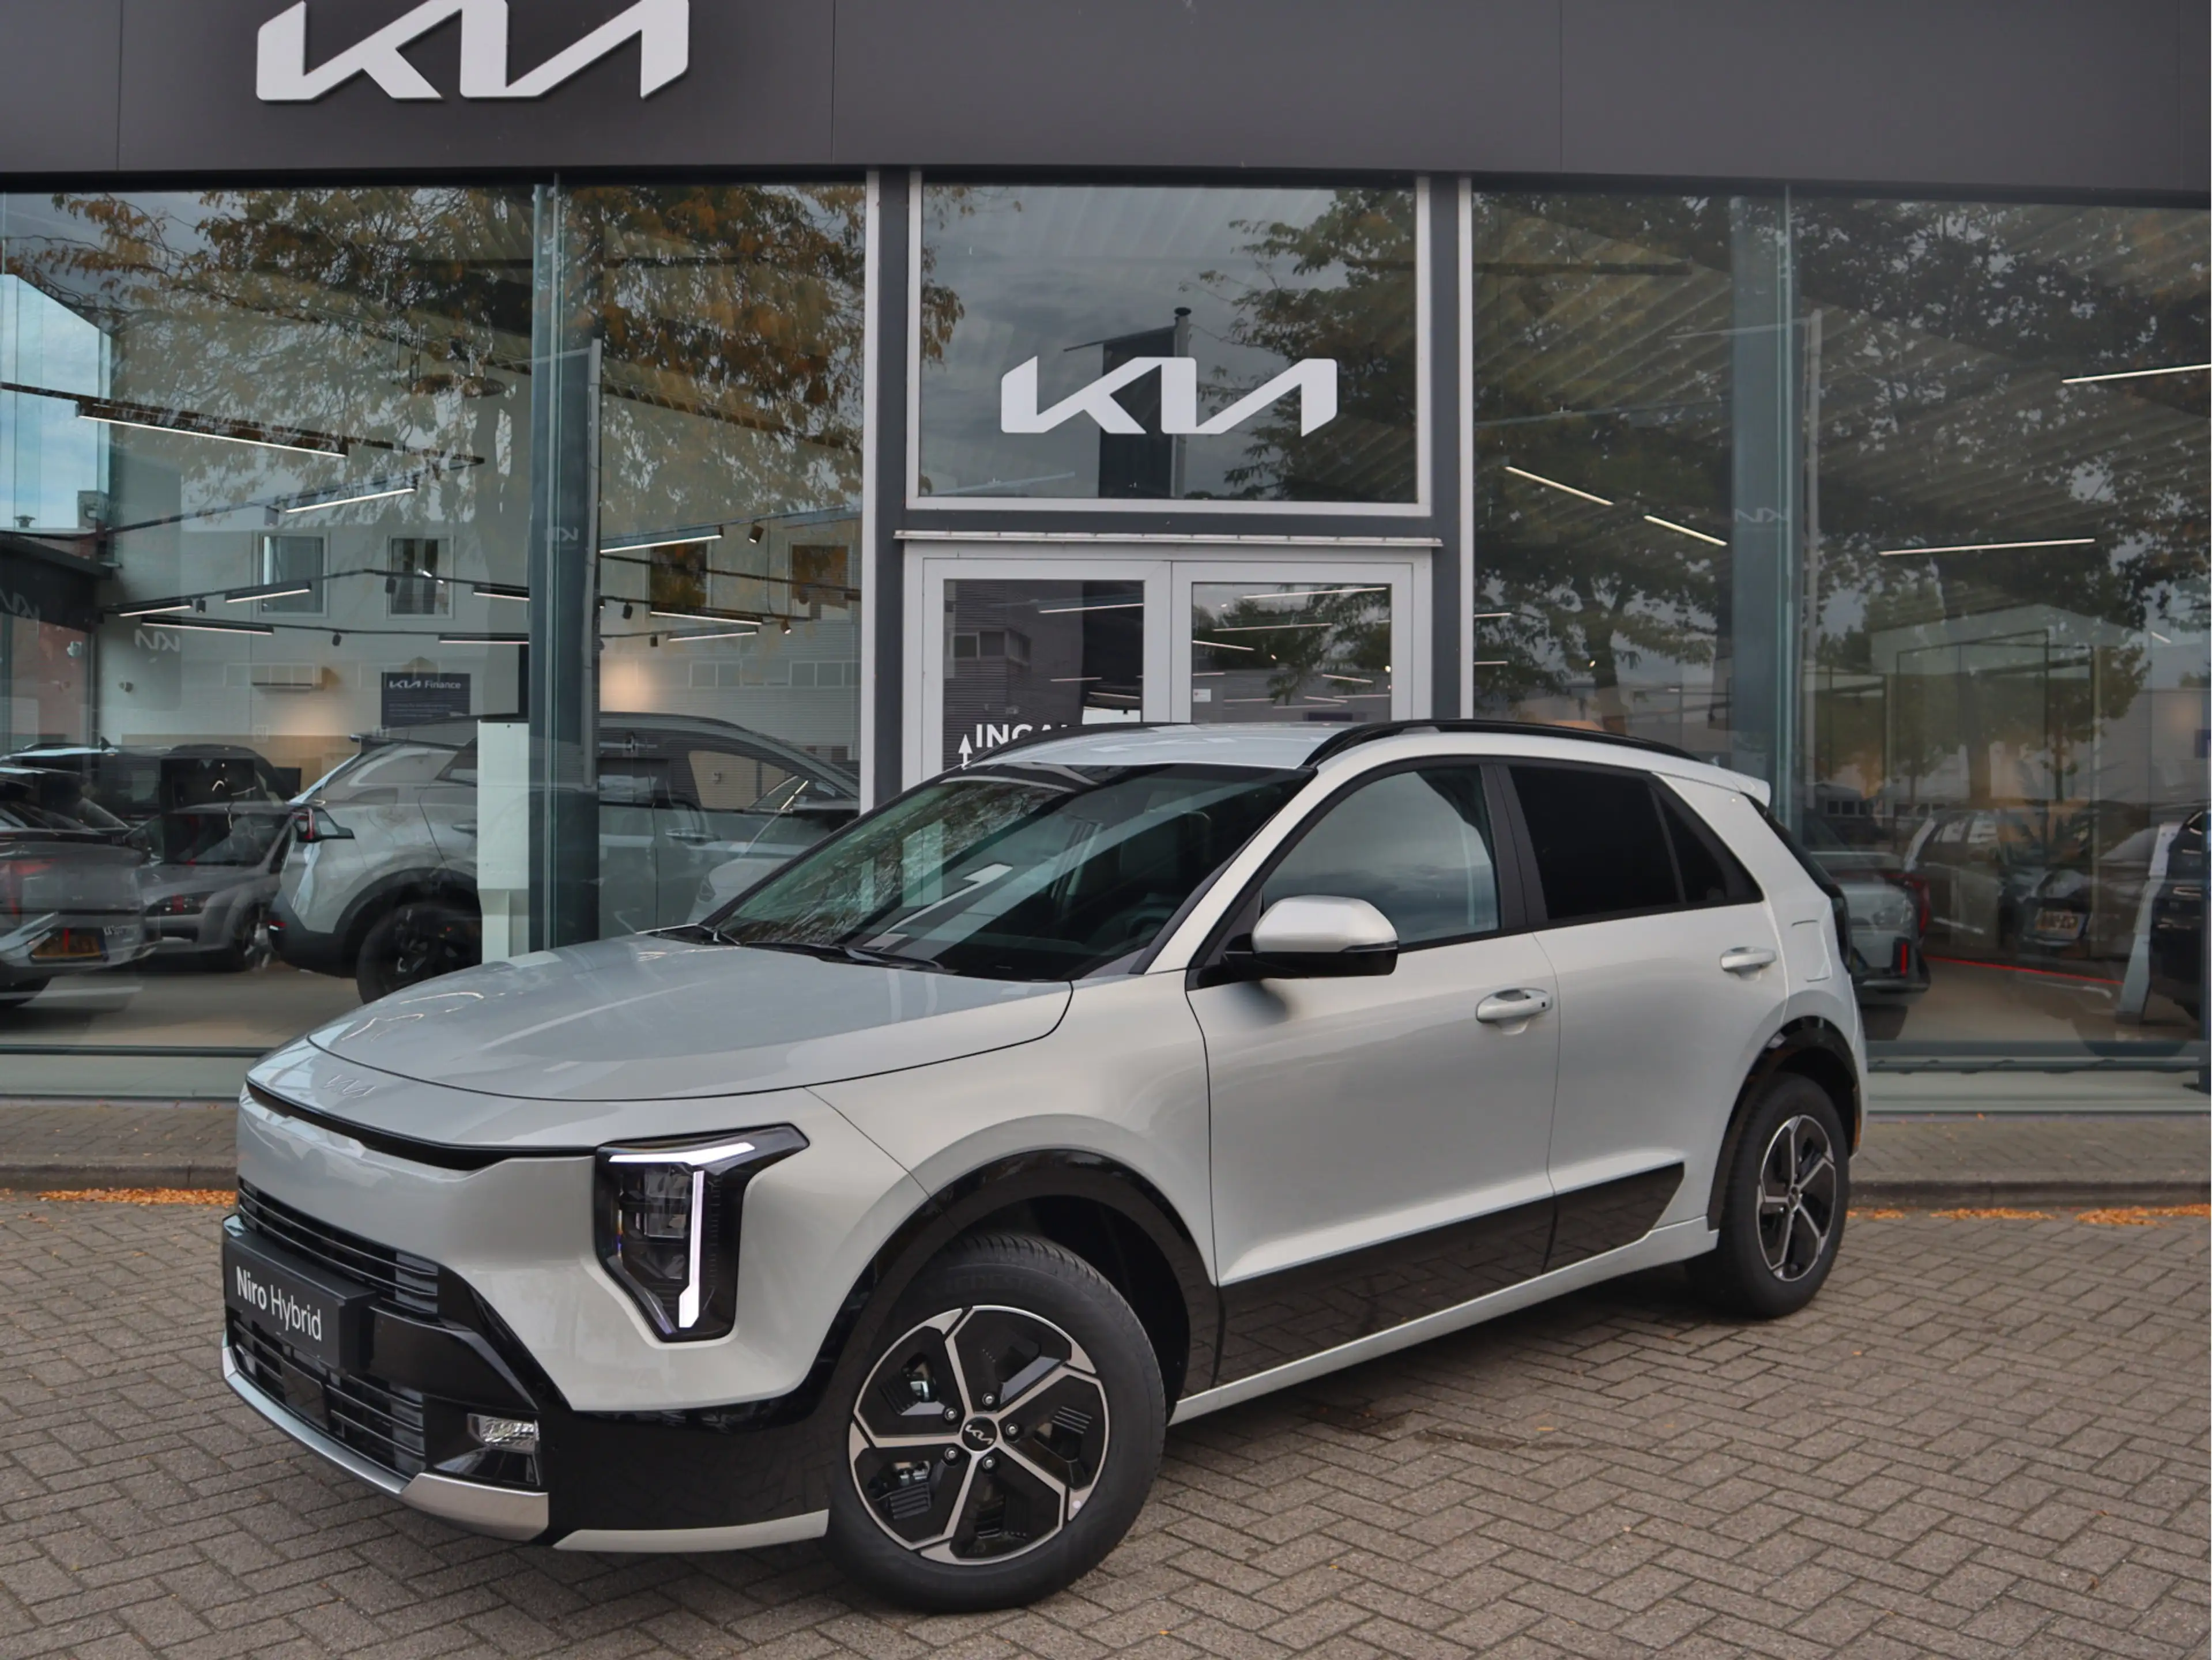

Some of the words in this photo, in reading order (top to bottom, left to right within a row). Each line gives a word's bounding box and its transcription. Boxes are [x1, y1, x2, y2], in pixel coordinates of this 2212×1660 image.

[257, 0, 689, 101] KIA
[1001, 356, 1337, 437] KIA
[389, 680, 421, 689] KIA
[424, 680, 461, 689] Finance
[319, 1074, 377, 1100] KIA
[236, 1266, 267, 1311] Niro
[270, 1284, 322, 1342] Hybrid
[964, 1424, 994, 1446] KIA
